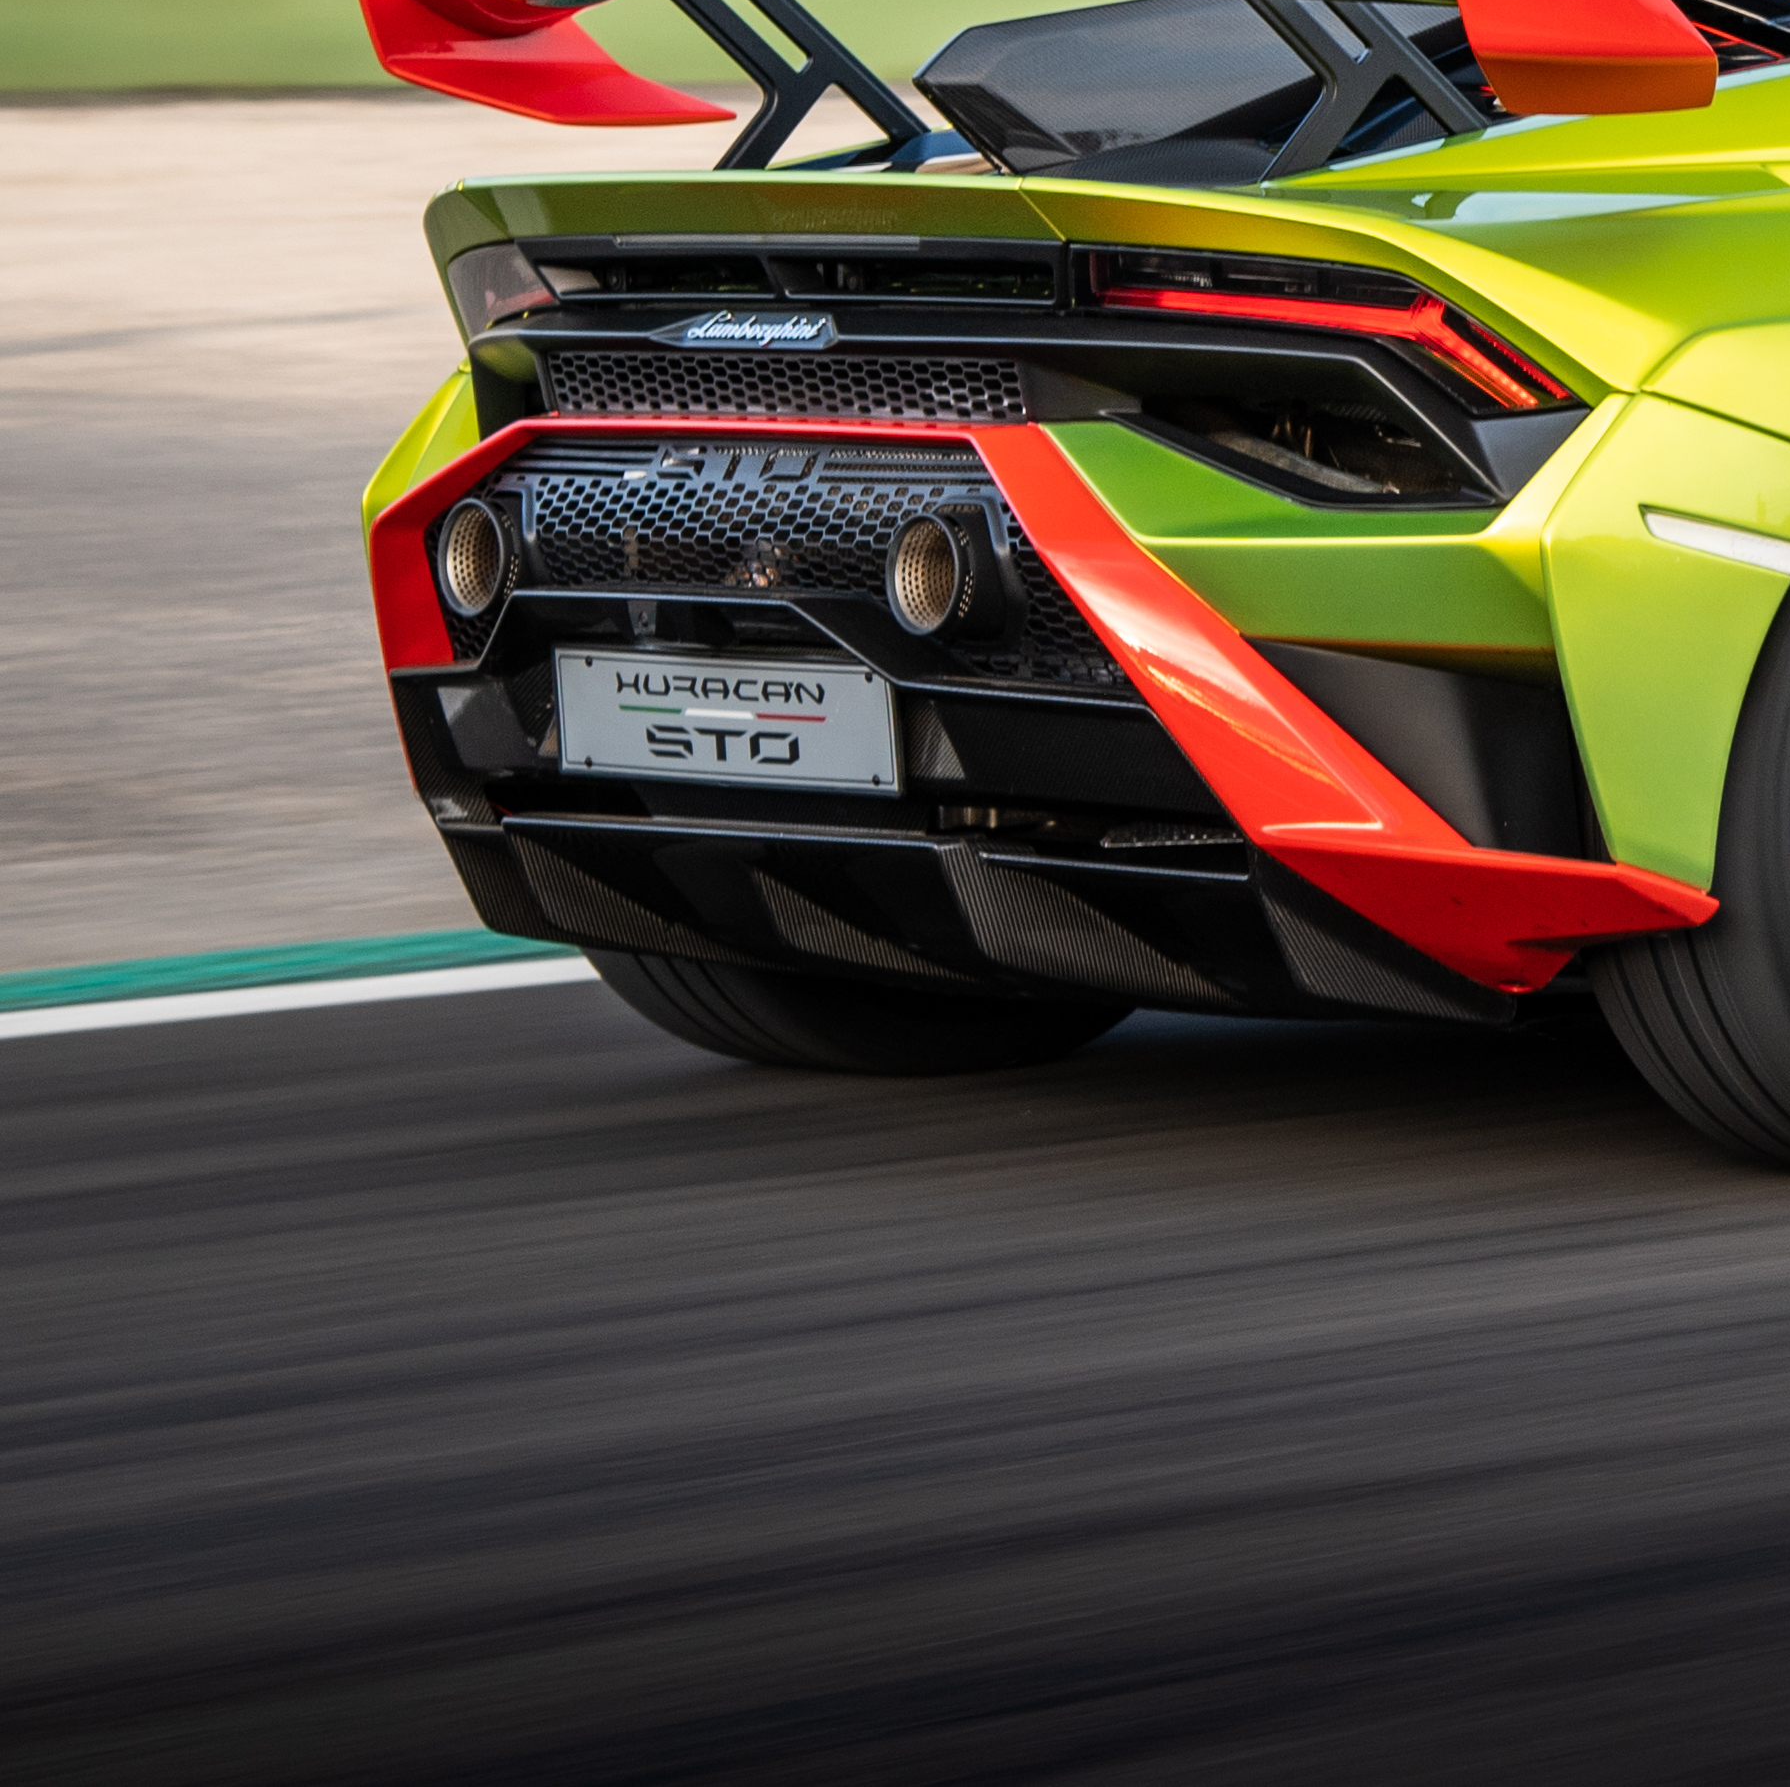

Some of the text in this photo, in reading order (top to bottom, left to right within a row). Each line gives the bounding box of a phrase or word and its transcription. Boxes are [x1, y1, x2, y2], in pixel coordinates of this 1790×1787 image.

[686, 309, 828, 348] Lamborghini
[656, 444, 821, 481] STO
[645, 724, 801, 765] STO
